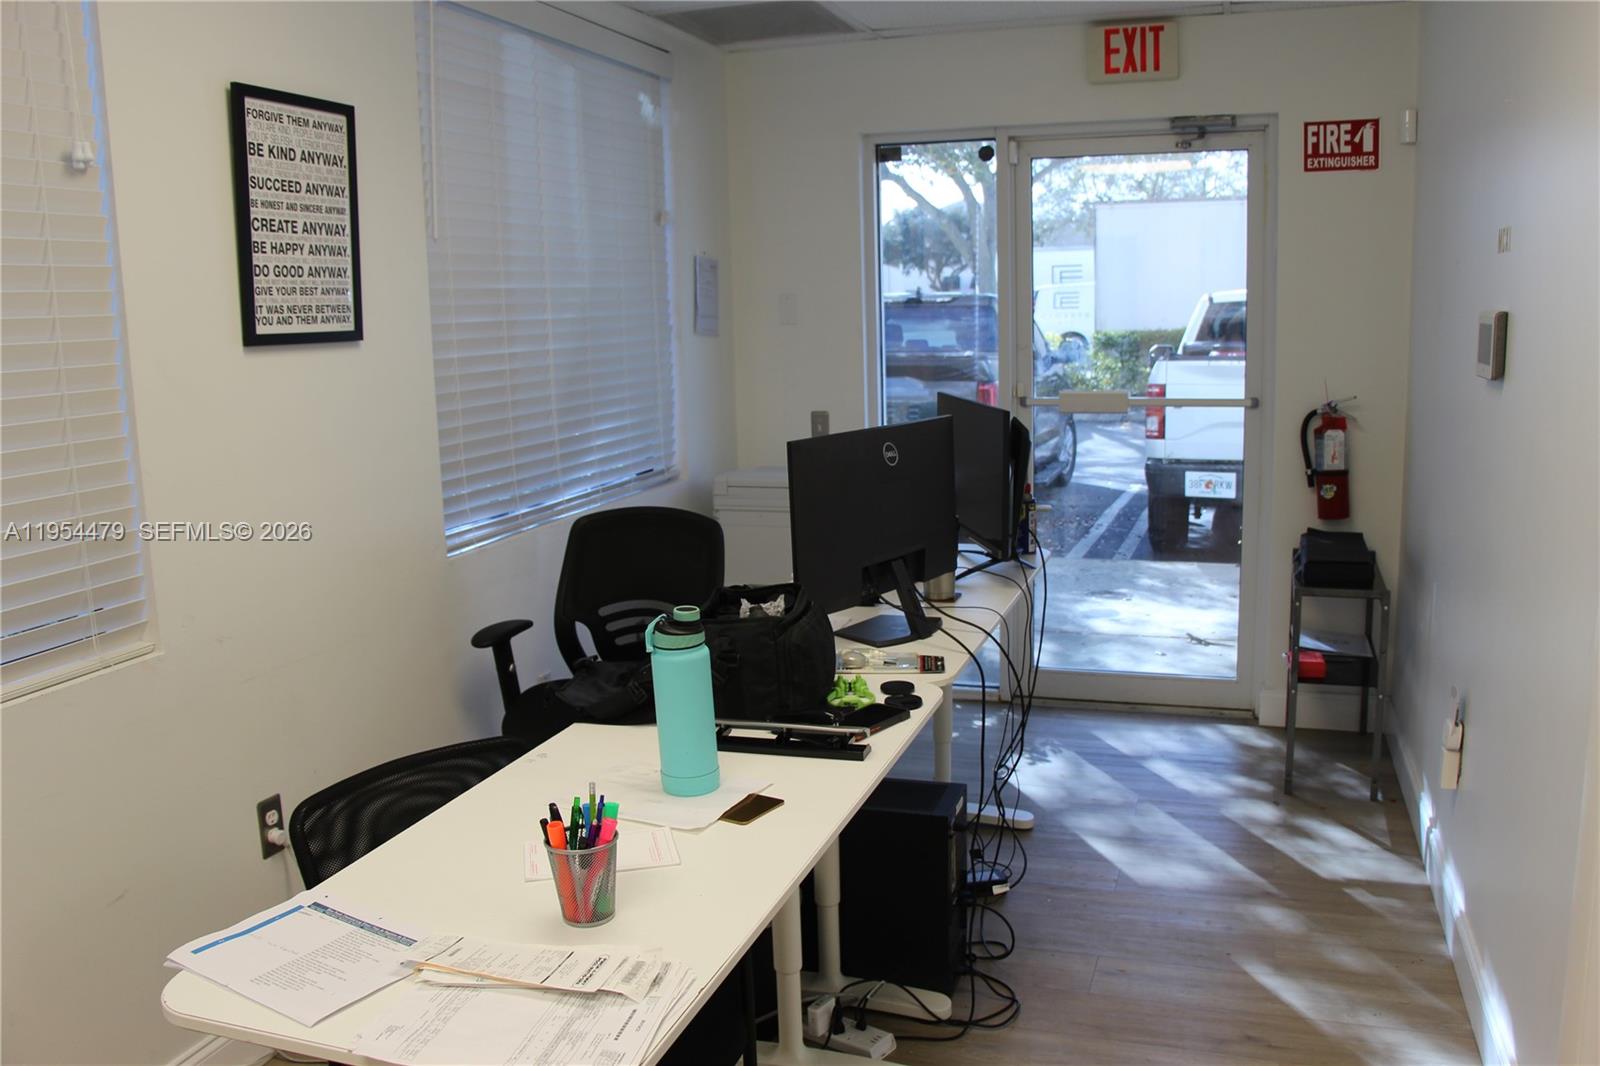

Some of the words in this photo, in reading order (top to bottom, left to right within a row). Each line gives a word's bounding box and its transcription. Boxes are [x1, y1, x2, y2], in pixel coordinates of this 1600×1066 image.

[1104, 25, 1164, 75] EXIT
[246, 107, 284, 124] FORGIVE
[287, 115, 310, 128] THEM
[312, 120, 345, 134] ANYWAY.
[1307, 123, 1351, 154] FIRE
[248, 142, 264, 157] BE
[268, 145, 296, 161] KIND
[300, 150, 346, 168] ANYWAY.
[1307, 155, 1375, 169] EXTINGUISHER
[250, 176, 302, 194] SUCCEED
[306, 183, 347, 198] ANYWAY.
[250, 198, 258, 208] BE
[260, 200, 284, 210] HONEST
[286, 202, 298, 212] AND
[300, 204, 324, 214] SINCERE
[252, 217, 298, 234] CREATE
[302, 221, 348, 237] ANYWAY.
[253, 241, 267, 254] BE
[270, 242, 304, 256] HAPPY
[308, 244, 350, 258] ANYWAY.
[254, 264, 269, 277] DO
[273, 265, 304, 278] GOOD
[308, 265, 350, 279] ANYWAY.
[255, 286, 273, 296] GIVE
[276, 286, 297, 296] YOUR
[300, 287, 318, 296] BEST
[256, 305, 263, 314] IT
[266, 305, 284, 314] WAS
[287, 305, 313, 314] NEVER
[316, 305, 351, 314] BETWEEN
[256, 317, 274, 326] YOU
[276, 316, 293, 325] AND
[296, 316, 318, 325] THEM
[320, 315, 351, 324] ANYWAY.
